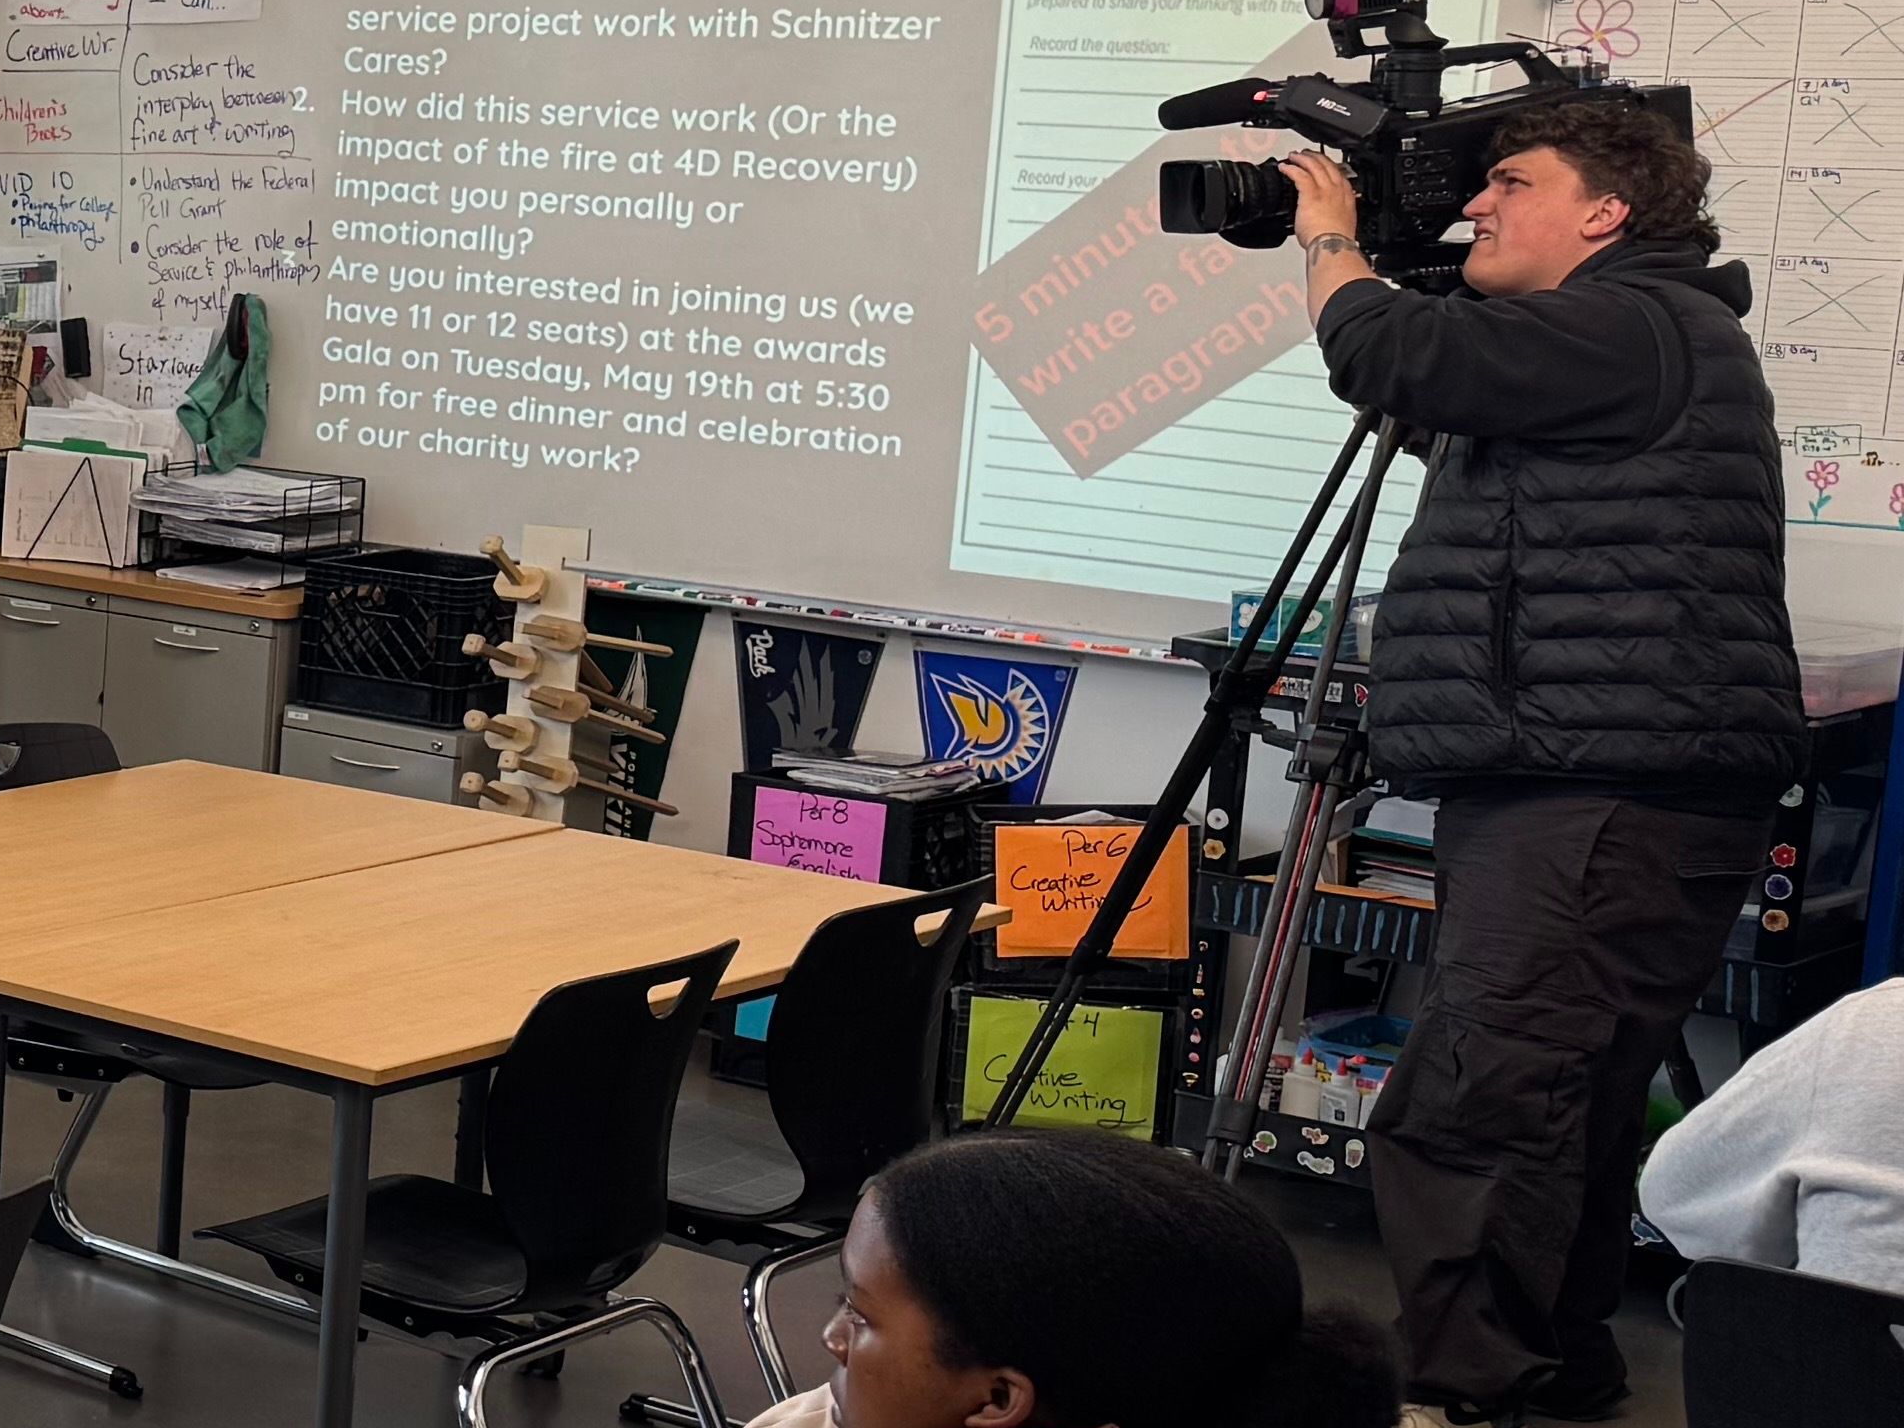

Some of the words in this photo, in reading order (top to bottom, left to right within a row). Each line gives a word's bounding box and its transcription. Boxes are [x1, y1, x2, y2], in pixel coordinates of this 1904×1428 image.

[346, 4, 457, 33] service
[466, 6, 583, 42] project
[593, 7, 676, 37] work
[688, 7, 759, 38] with
[770, 7, 942, 40] Schnitzer
[344, 46, 448, 76] Cares?
[1030, 37, 1078, 52] Record
[1081, 38, 1104, 52] the
[1106, 37, 1171, 56] question:
[134, 53, 219, 86] Consider
[223, 54, 256, 80] the
[291, 86, 315, 112] 2.
[341, 89, 407, 118] How
[416, 91, 465, 121] did
[474, 94, 531, 125] this
[540, 99, 660, 130] service
[671, 102, 757, 133] work
[768, 104, 827, 141] (Or
[837, 104, 897, 137] the
[52, 172, 74, 190] 10
[142, 169, 221, 192] Understand
[338, 129, 444, 165] impact
[453, 137, 489, 165] of
[497, 139, 550, 169] the
[560, 141, 618, 173] fire
[628, 149, 664, 175] at
[673, 148, 721, 177] 4D
[732, 150, 918, 192] Recovery)
[335, 171, 440, 207] impact
[450, 186, 508, 214] you
[518, 191, 694, 229] personally
[705, 201, 745, 224] or
[331, 219, 534, 261] emotionally?
[327, 255, 379, 284] Are
[389, 265, 445, 293] you
[455, 264, 621, 305] interested
[632, 278, 660, 308] in
[668, 281, 786, 323] joining
[799, 296, 838, 320] us
[849, 293, 915, 328] (we
[325, 293, 398, 327] have
[408, 303, 432, 330] 11
[442, 312, 477, 334] or
[486, 311, 517, 339] 12
[526, 320, 629, 354] seats)
[639, 327, 675, 352] at
[685, 326, 742, 357] the
[753, 337, 887, 368] awards
[974, 302, 1015, 343] 5
[1017, 308, 1137, 397] write
[1144, 282, 1180, 316] a
[322, 336, 392, 367] Gala
[401, 349, 439, 372] on
[450, 348, 591, 393] Tuesday,
[603, 363, 673, 401] May
[685, 370, 753, 401] 19th
[766, 379, 804, 405] at
[815, 379, 890, 412] 5:30
[1062, 281, 1306, 460] paragraph
[318, 382, 366, 407] pm
[376, 381, 423, 410] for
[432, 387, 498, 419] free
[508, 395, 614, 429] dinner
[622, 410, 687, 437] and
[698, 415, 902, 457] celebration
[316, 417, 350, 443] of
[357, 426, 411, 449] our
[418, 427, 530, 469] charity
[540, 444, 641, 473] work?
[1062, 829, 1103, 866] Per
[1106, 833, 1129, 857] 6
[1011, 866, 1101, 893] Creative
[1029, 1089, 1147, 1128] Writing
